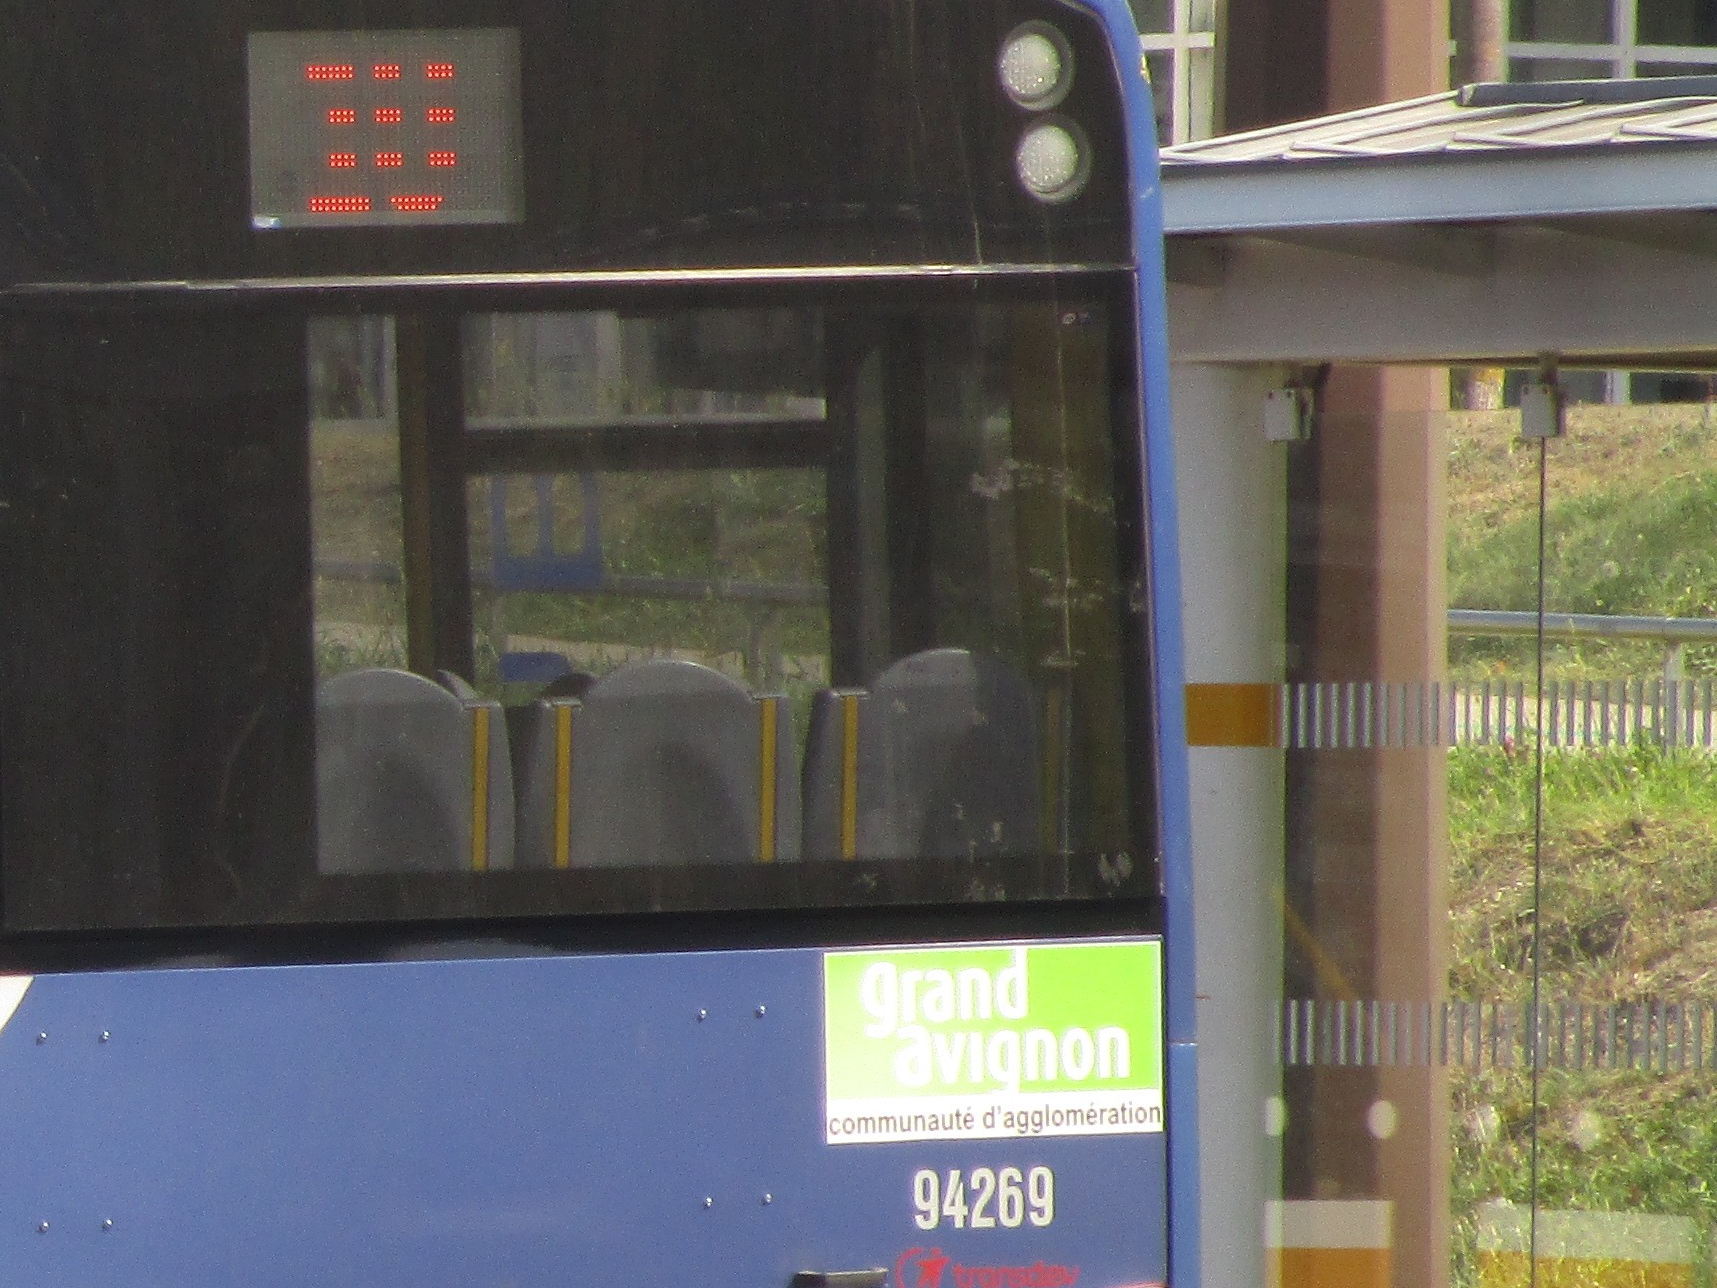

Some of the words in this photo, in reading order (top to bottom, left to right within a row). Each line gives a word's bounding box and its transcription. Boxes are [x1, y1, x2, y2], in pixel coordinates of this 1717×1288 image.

[862, 947, 1028, 1039] grand
[893, 1024, 1132, 1094] avignon
[829, 1106, 975, 1137] communauté
[982, 1101, 1162, 1138] d'agglomération
[913, 1165, 1056, 1231] 94269
